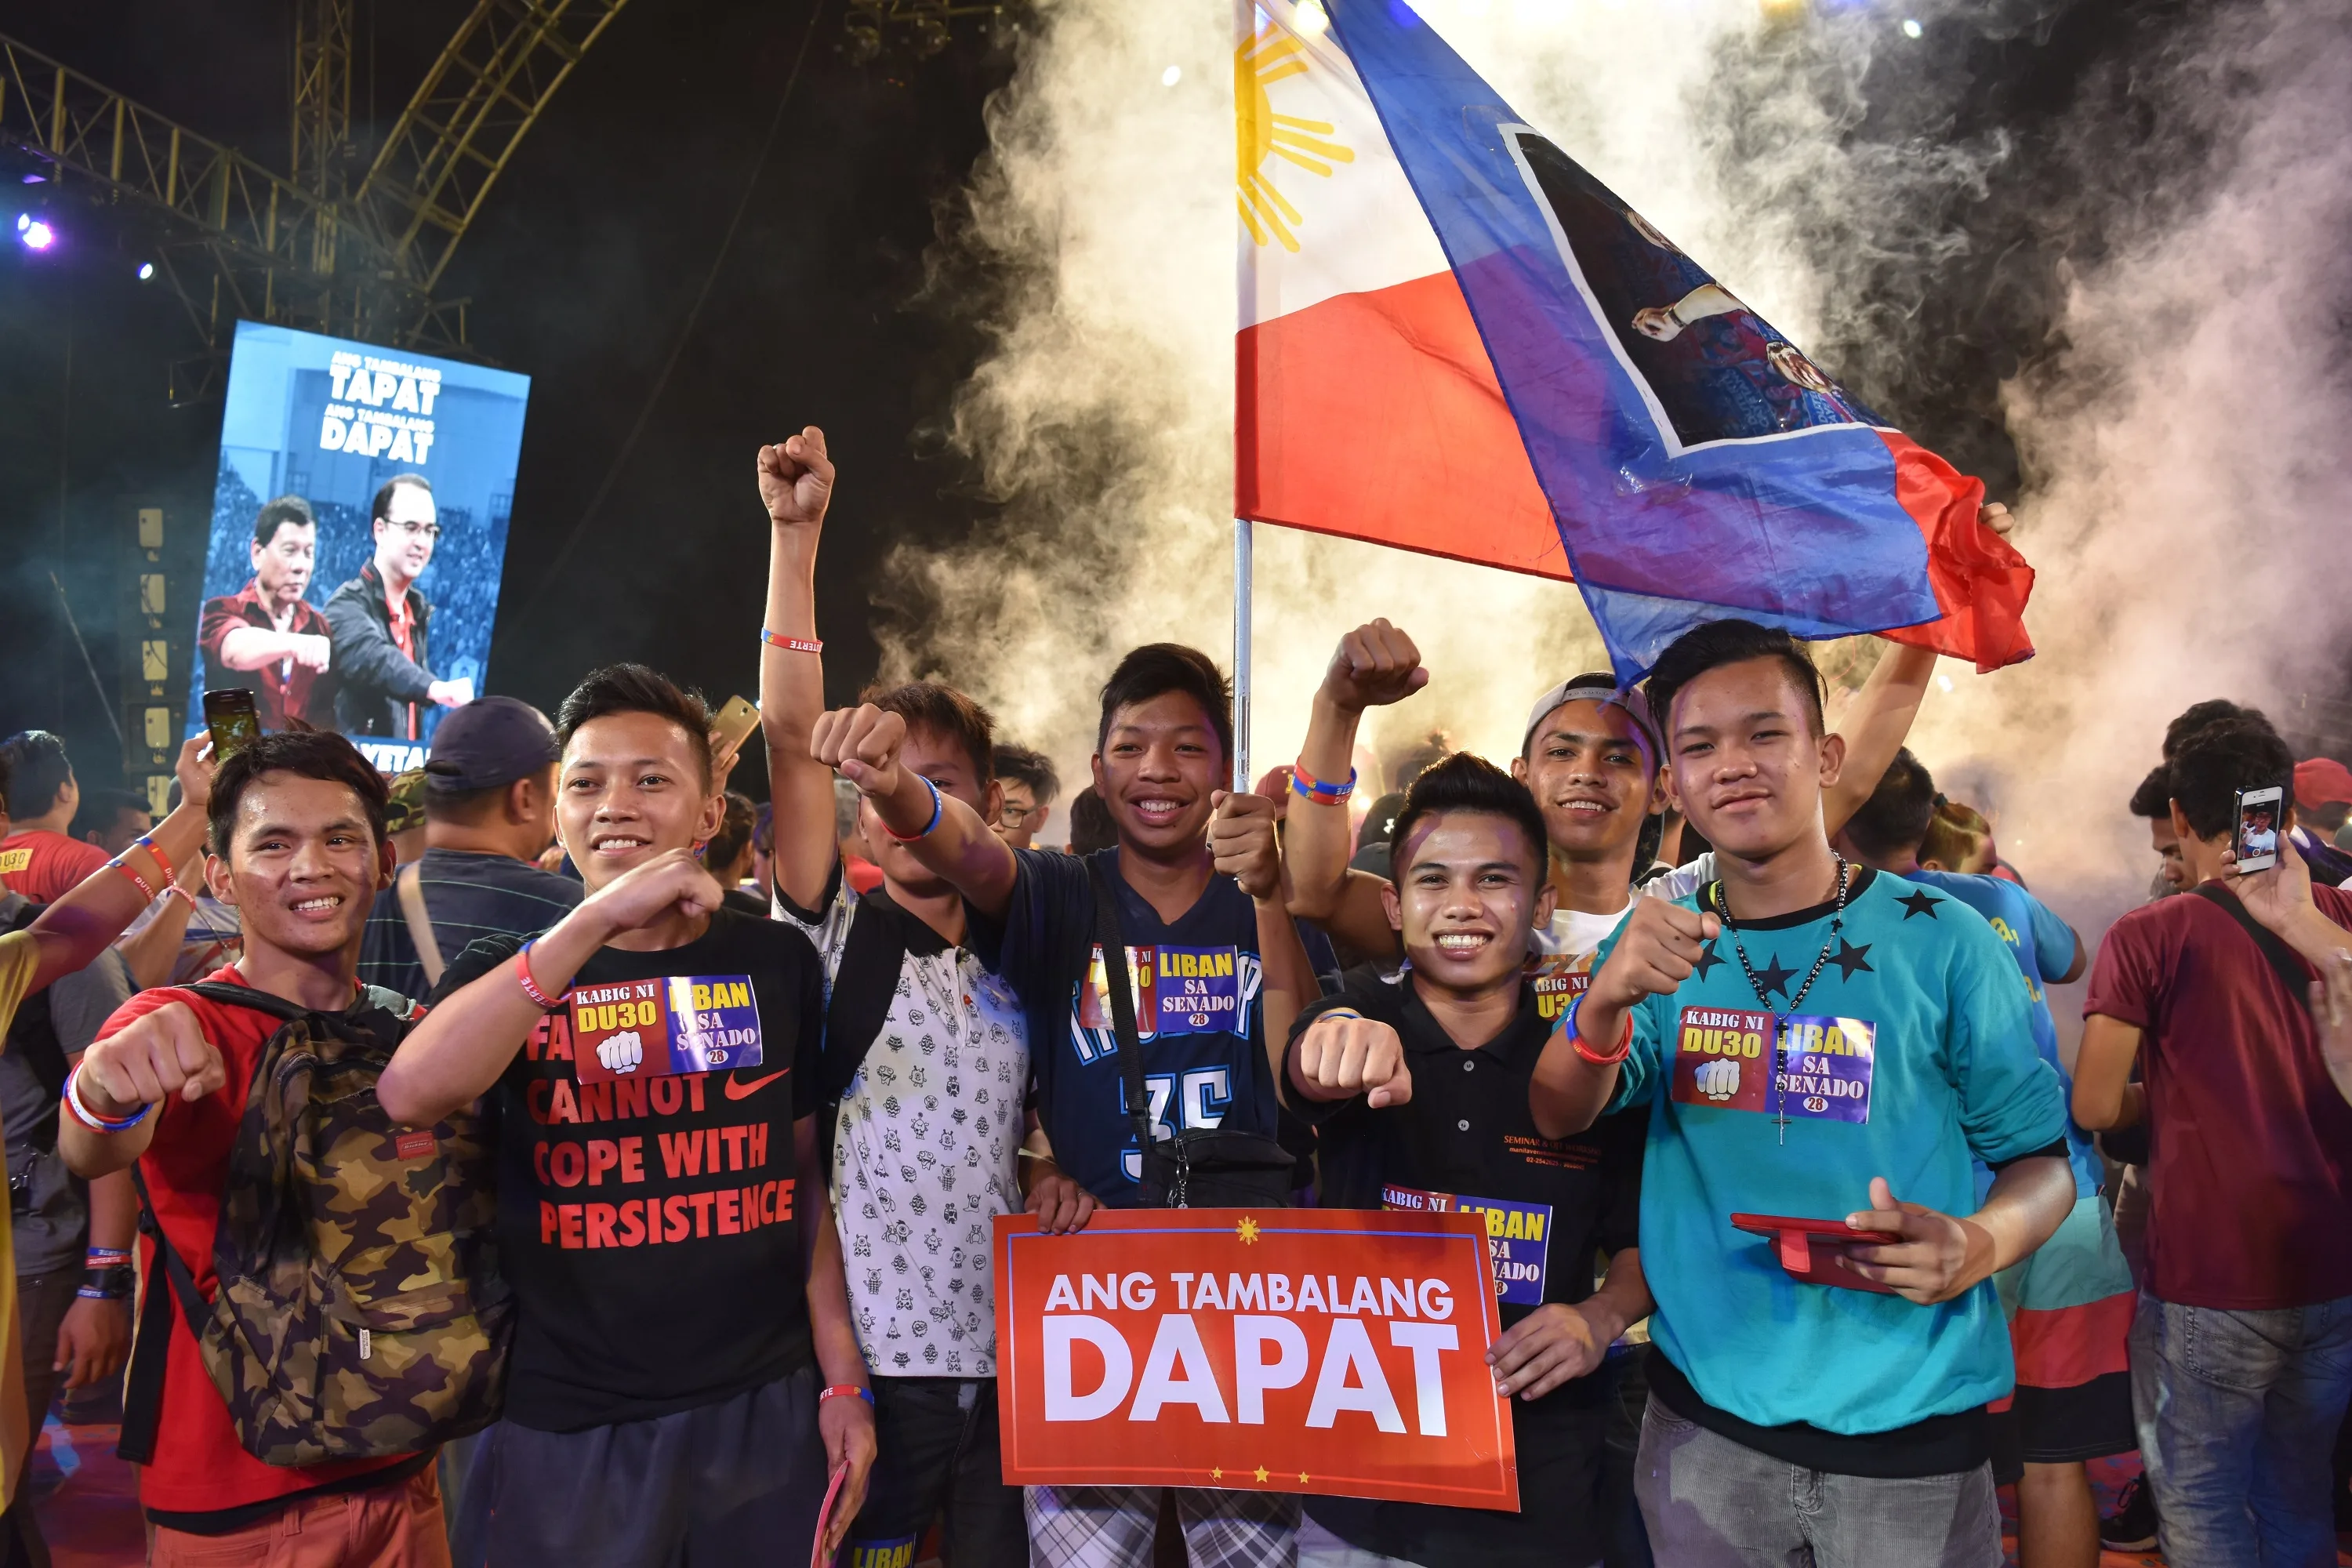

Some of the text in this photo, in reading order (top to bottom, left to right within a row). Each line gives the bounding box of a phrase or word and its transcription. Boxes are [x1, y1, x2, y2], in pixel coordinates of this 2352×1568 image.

[329, 363, 441, 416] TAPAT
[320, 416, 434, 465] DAPAT
[1142, 950, 1151, 963] NI
[1160, 953, 1233, 978] LIBAN
[576, 984, 655, 1005] KABIG NI
[1185, 979, 1208, 994] SA
[1571, 977, 1588, 989] NI
[1162, 995, 1235, 1012] SENADO
[1538, 993, 1583, 1018] U3
[577, 1000, 657, 1033] DU30
[698, 1012, 724, 1029] SA
[1192, 1014, 1205, 1025] 28
[1686, 1011, 1764, 1030] KABIG NI
[1682, 1028, 1761, 1058] DU30
[1776, 1022, 1872, 1058] LIBAN
[710, 1050, 724, 1062] 28
[1802, 1056, 1831, 1075] SA
[1775, 1074, 1864, 1098] SENADO
[526, 1073, 710, 1125] CANNOT
[1808, 1098, 1823, 1110] 28
[1504, 1135, 1541, 1146] SEMINAR
[533, 1123, 768, 1188] COPE WITH
[1381, 1188, 1447, 1212] KABIG NI
[539, 1178, 796, 1249] PERSISTENCE
[1044, 1272, 1454, 1320] ANG TAMBALANG
[1495, 1282, 1503, 1294] 8
[1042, 1313, 1459, 1436] DAPAT
[853, 1541, 913, 1568] LIBAN
